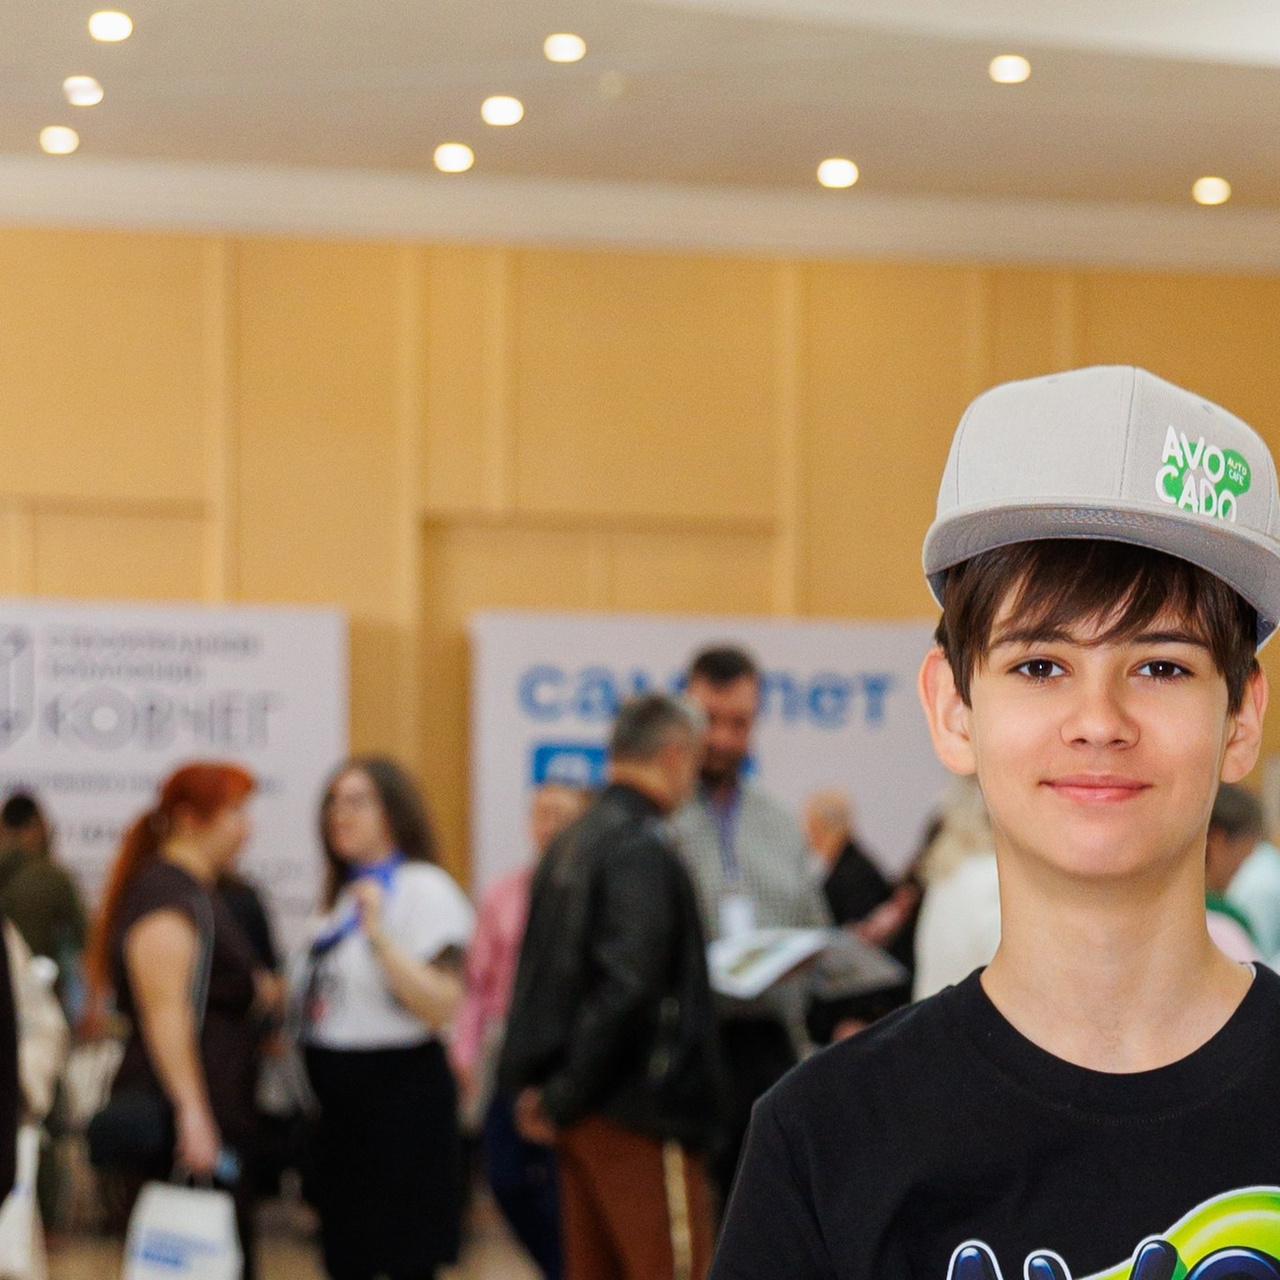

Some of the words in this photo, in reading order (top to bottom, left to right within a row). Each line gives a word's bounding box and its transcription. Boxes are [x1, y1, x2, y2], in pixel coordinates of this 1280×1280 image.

[1162, 425, 1226, 483] AVO
[1227, 457, 1247, 476] AUTO
[1155, 465, 1237, 522] CADO
